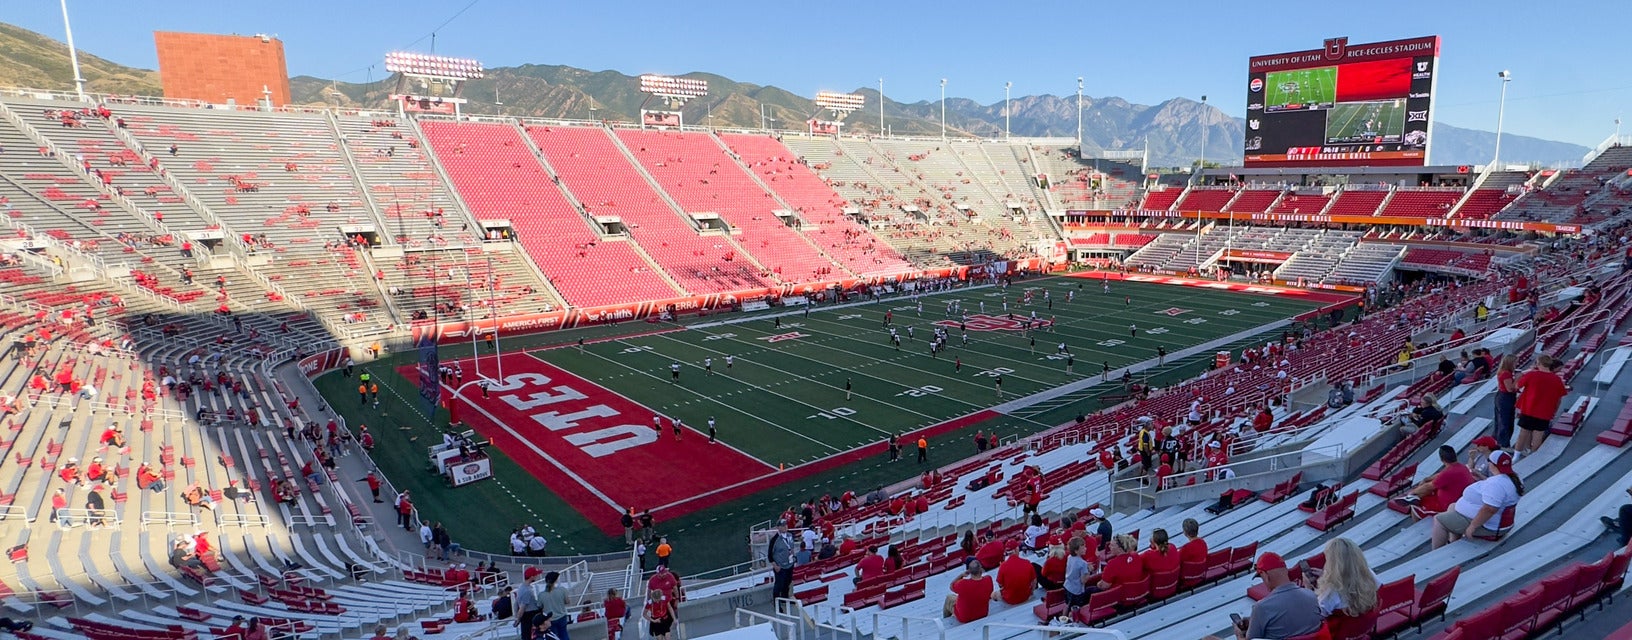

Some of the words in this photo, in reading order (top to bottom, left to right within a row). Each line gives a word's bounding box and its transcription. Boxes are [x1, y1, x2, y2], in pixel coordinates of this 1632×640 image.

[1323, 37, 1348, 60] U
[1347, 46, 1393, 57] RICE-ECCLES
[1395, 42, 1432, 52] STADIUM
[1252, 58, 1290, 67] UNIVERSITY
[1302, 54, 1321, 62] UTAH
[1426, 218, 1447, 226] WITH
[1460, 219, 1497, 228] TRAEGER
[1501, 221, 1524, 229] GRILL
[658, 300, 699, 312] dERRA
[600, 309, 633, 320] Smith's
[502, 319, 537, 329] AMERICA
[538, 316, 560, 325] FIRST
[903, 385, 944, 397] 20
[486, 373, 659, 458] UTES
[817, 407, 857, 420] 10
